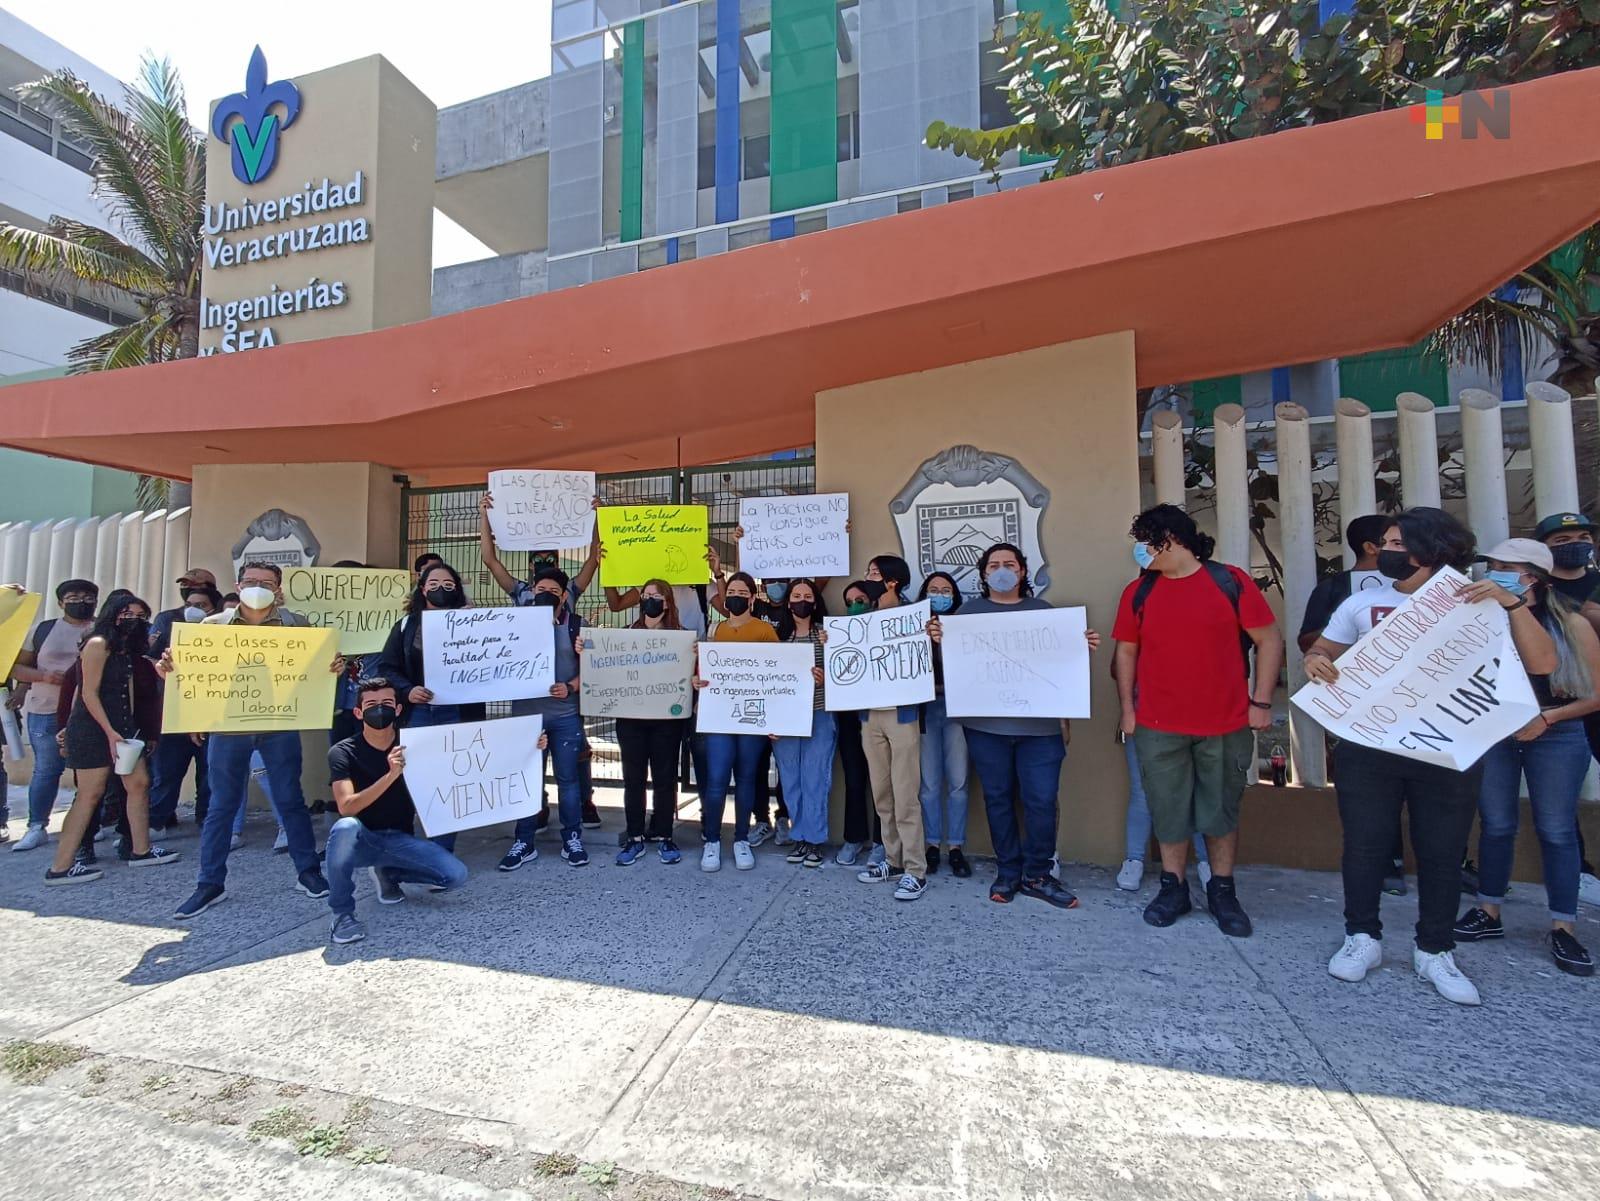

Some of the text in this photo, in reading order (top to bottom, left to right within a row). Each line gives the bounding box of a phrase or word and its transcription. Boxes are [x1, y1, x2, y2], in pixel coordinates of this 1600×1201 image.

[204, 170, 364, 235] Universidad
[203, 217, 368, 269] Veracruzana
[200, 278, 345, 333] Ingenierías
[531, 473, 589, 492] CLASES
[534, 490, 553, 502] EN
[557, 497, 590, 520] NO
[741, 498, 757, 516] La
[828, 497, 848, 512] NO
[623, 510, 639, 522] La
[507, 521, 531, 536] SON
[612, 521, 656, 535] mental
[793, 531, 813, 546] de
[818, 531, 840, 542] una
[289, 570, 406, 602] QUEREMOS
[177, 630, 307, 650] Las clases en
[829, 615, 873, 649] SOY
[496, 645, 512, 659] de
[631, 641, 638, 650] A
[645, 638, 668, 650] SER
[178, 651, 295, 667] línea NO te
[707, 650, 778, 667] Queremos ser
[176, 671, 308, 690] preparan para
[626, 670, 639, 681] NO
[711, 672, 755, 685] ingenieros
[1350, 612, 1502, 746] NO SE APRENDE
[184, 685, 262, 699] el mundo
[709, 687, 720, 695] no
[762, 685, 796, 696] virtuales
[242, 698, 298, 713] laboral
[1398, 717, 1454, 752] EN
